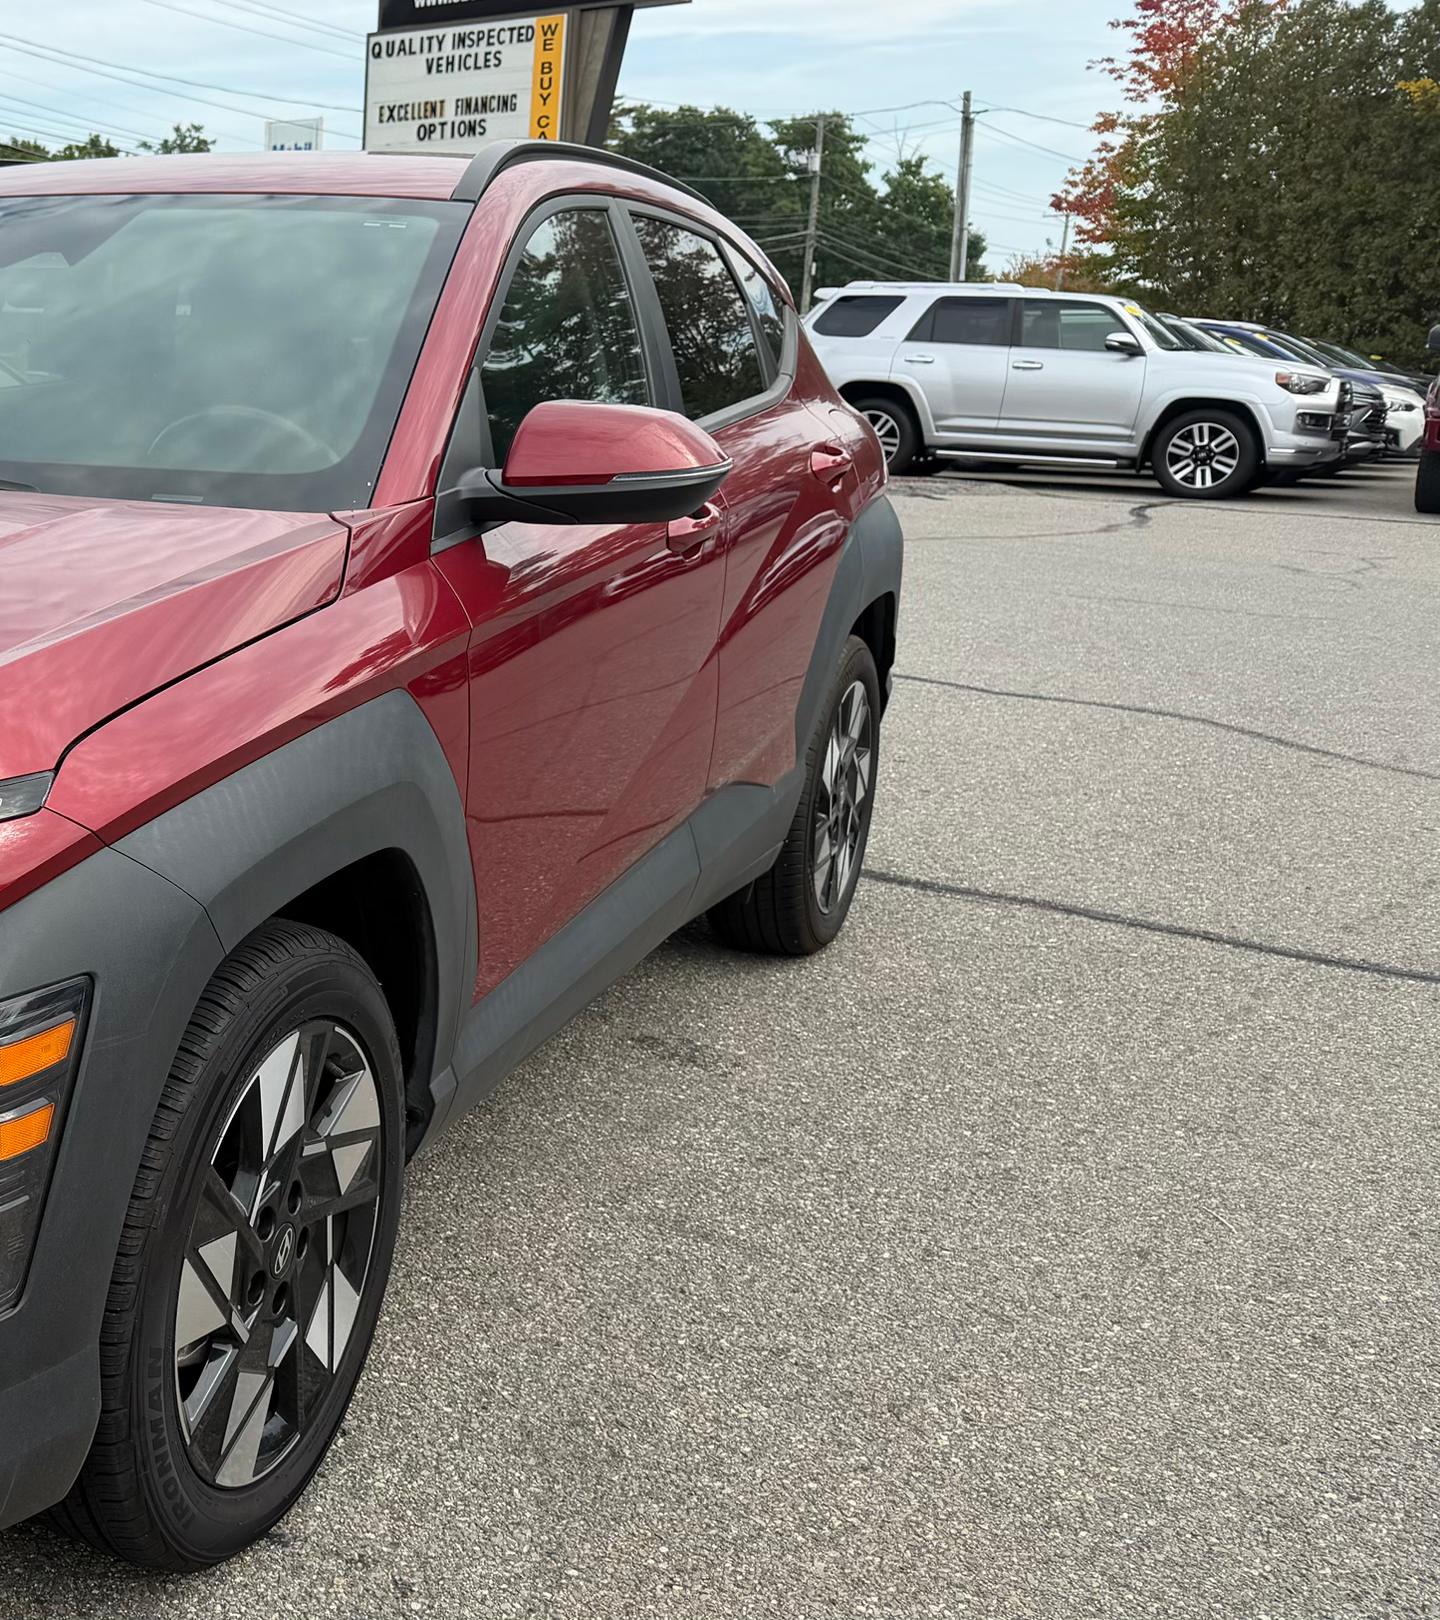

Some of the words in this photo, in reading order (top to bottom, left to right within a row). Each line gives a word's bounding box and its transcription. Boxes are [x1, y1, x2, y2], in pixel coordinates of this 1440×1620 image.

[371, 33, 446, 59] QUALITY
[452, 24, 535, 51] INSPECTED
[541, 22, 559, 52] WE
[425, 50, 502, 75] VEHICLES
[540, 61, 553, 107] BUY
[378, 99, 446, 124] EXCELLENT
[454, 93, 518, 118] FINANCING
[417, 118, 487, 142] OPTIONS
[536, 115, 551, 140] CA
[146, 1346, 196, 1531] IRONMAN
